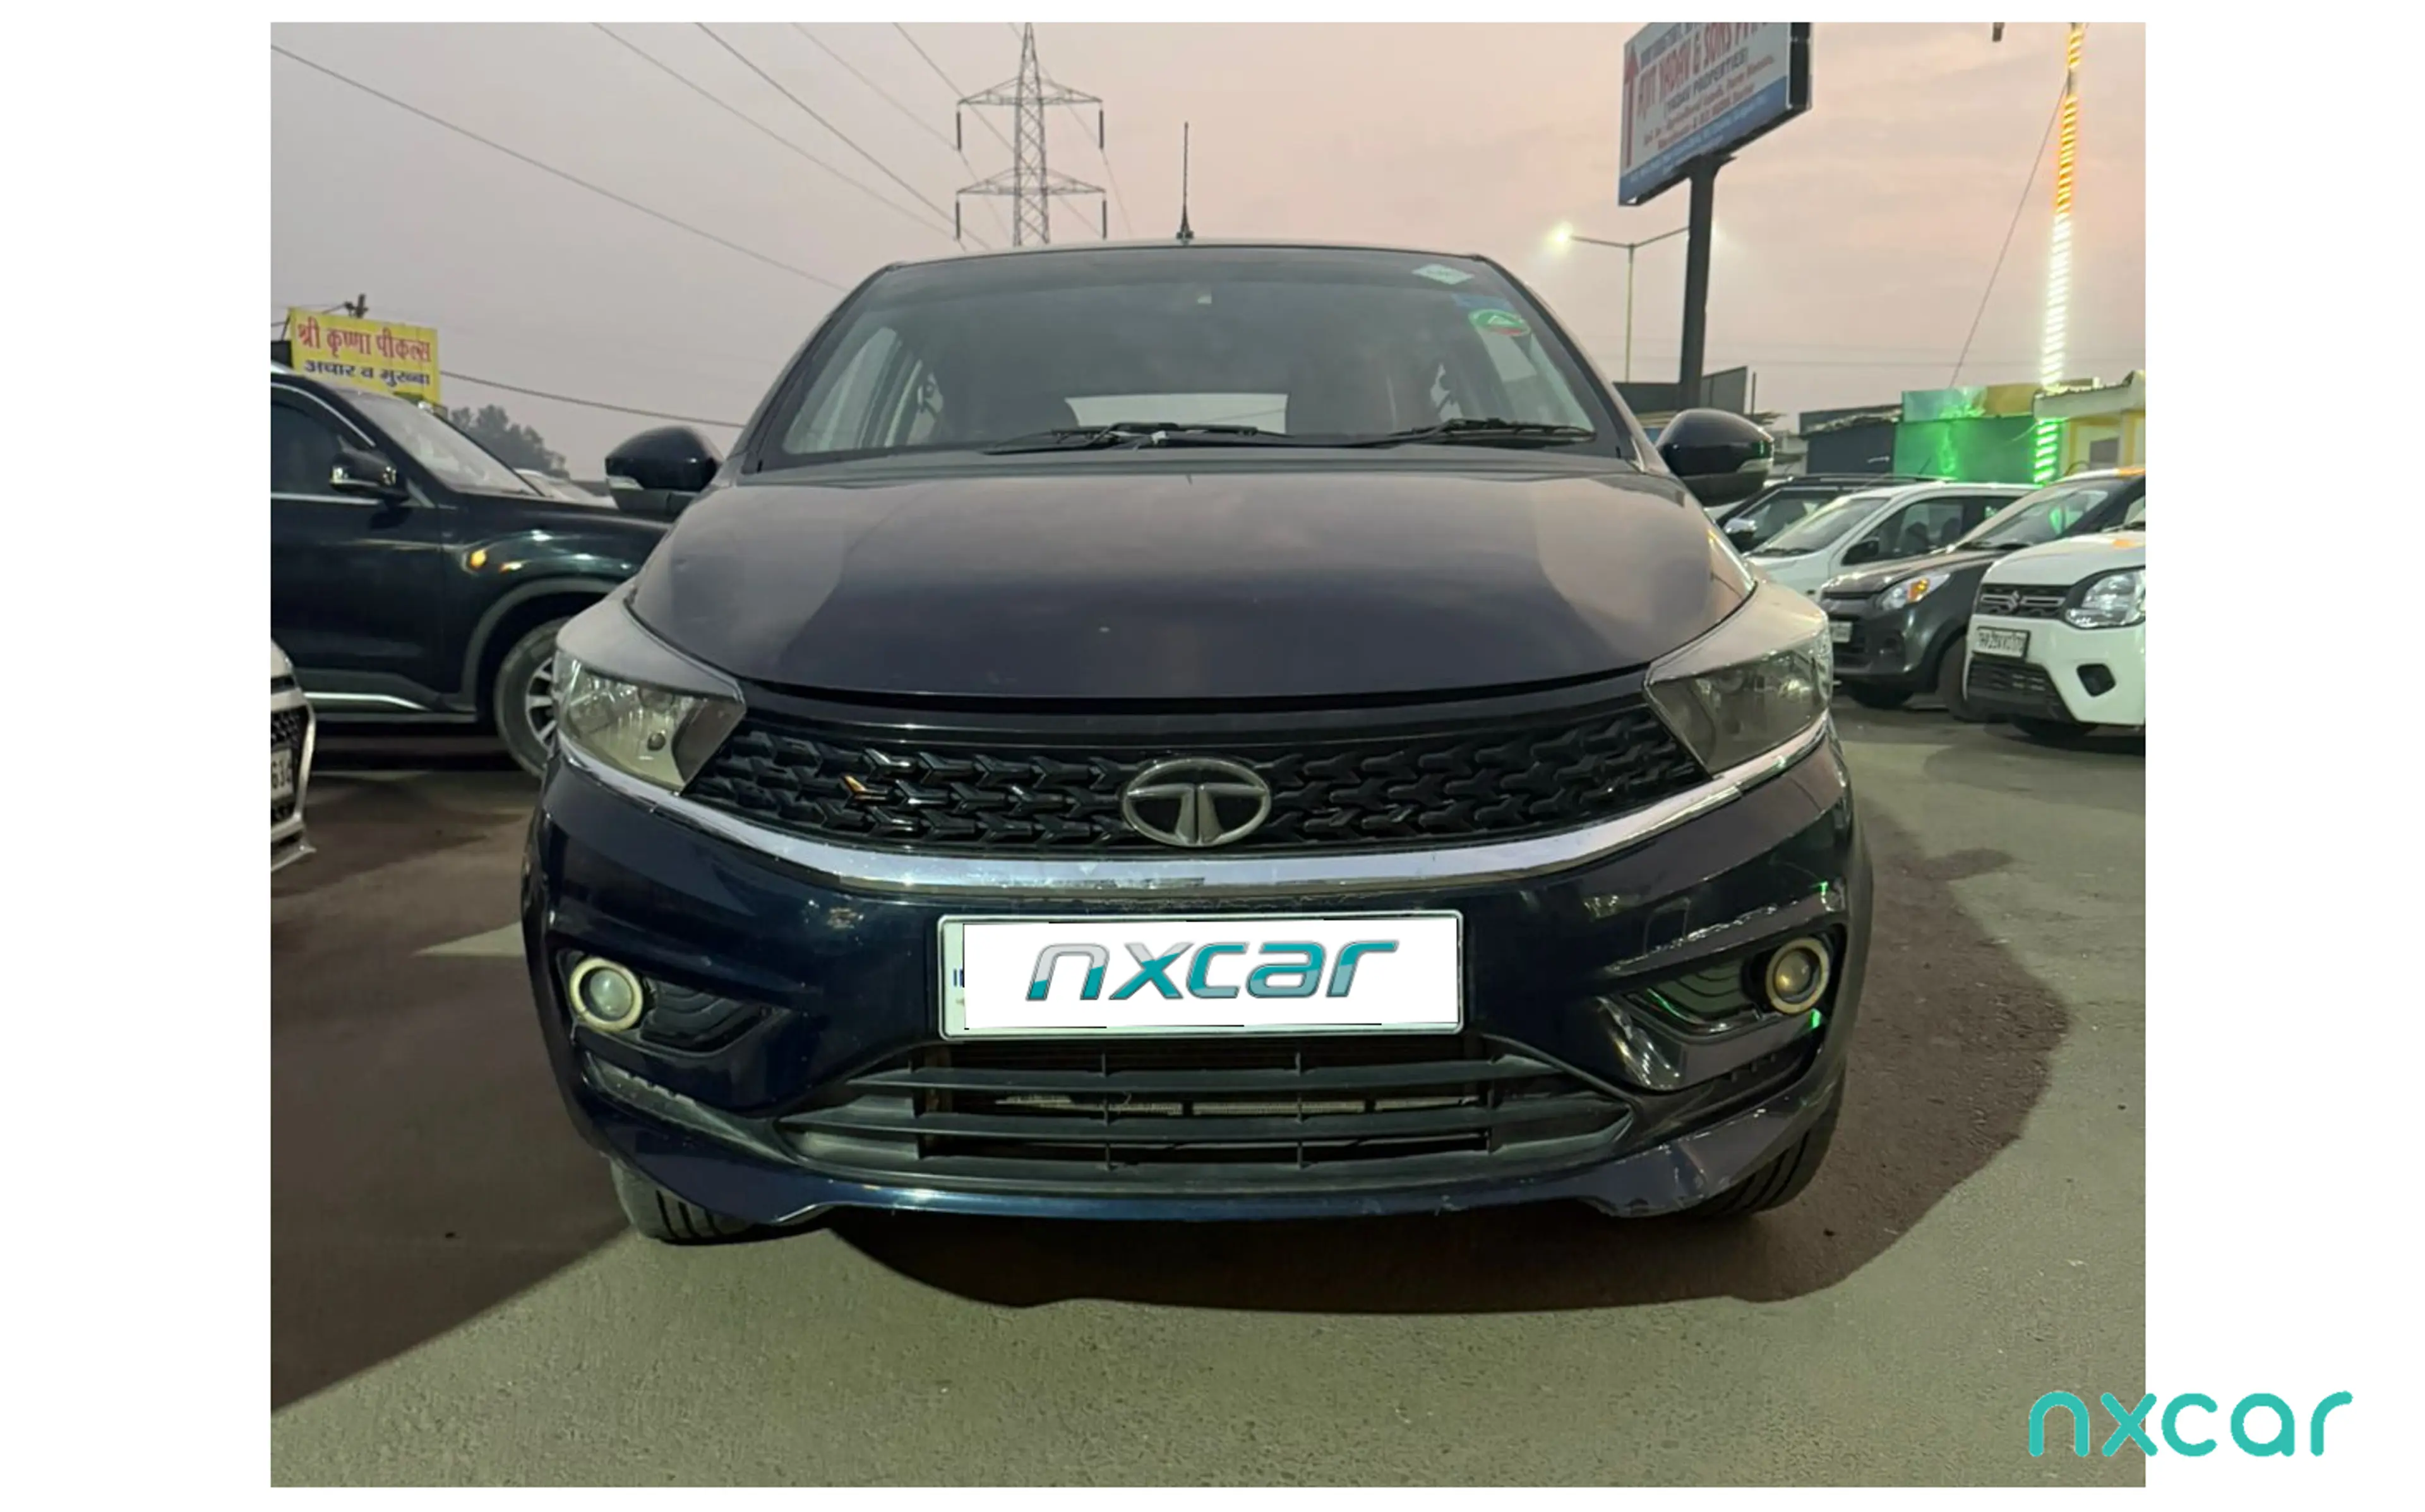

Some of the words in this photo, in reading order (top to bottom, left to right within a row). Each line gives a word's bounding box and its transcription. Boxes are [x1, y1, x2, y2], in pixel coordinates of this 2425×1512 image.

[1658, 37, 1691, 105] YADAV
[297, 316, 321, 348] श्री
[326, 328, 371, 358] कृष्णा
[304, 359, 356, 377] अचार
[361, 366, 374, 379] व
